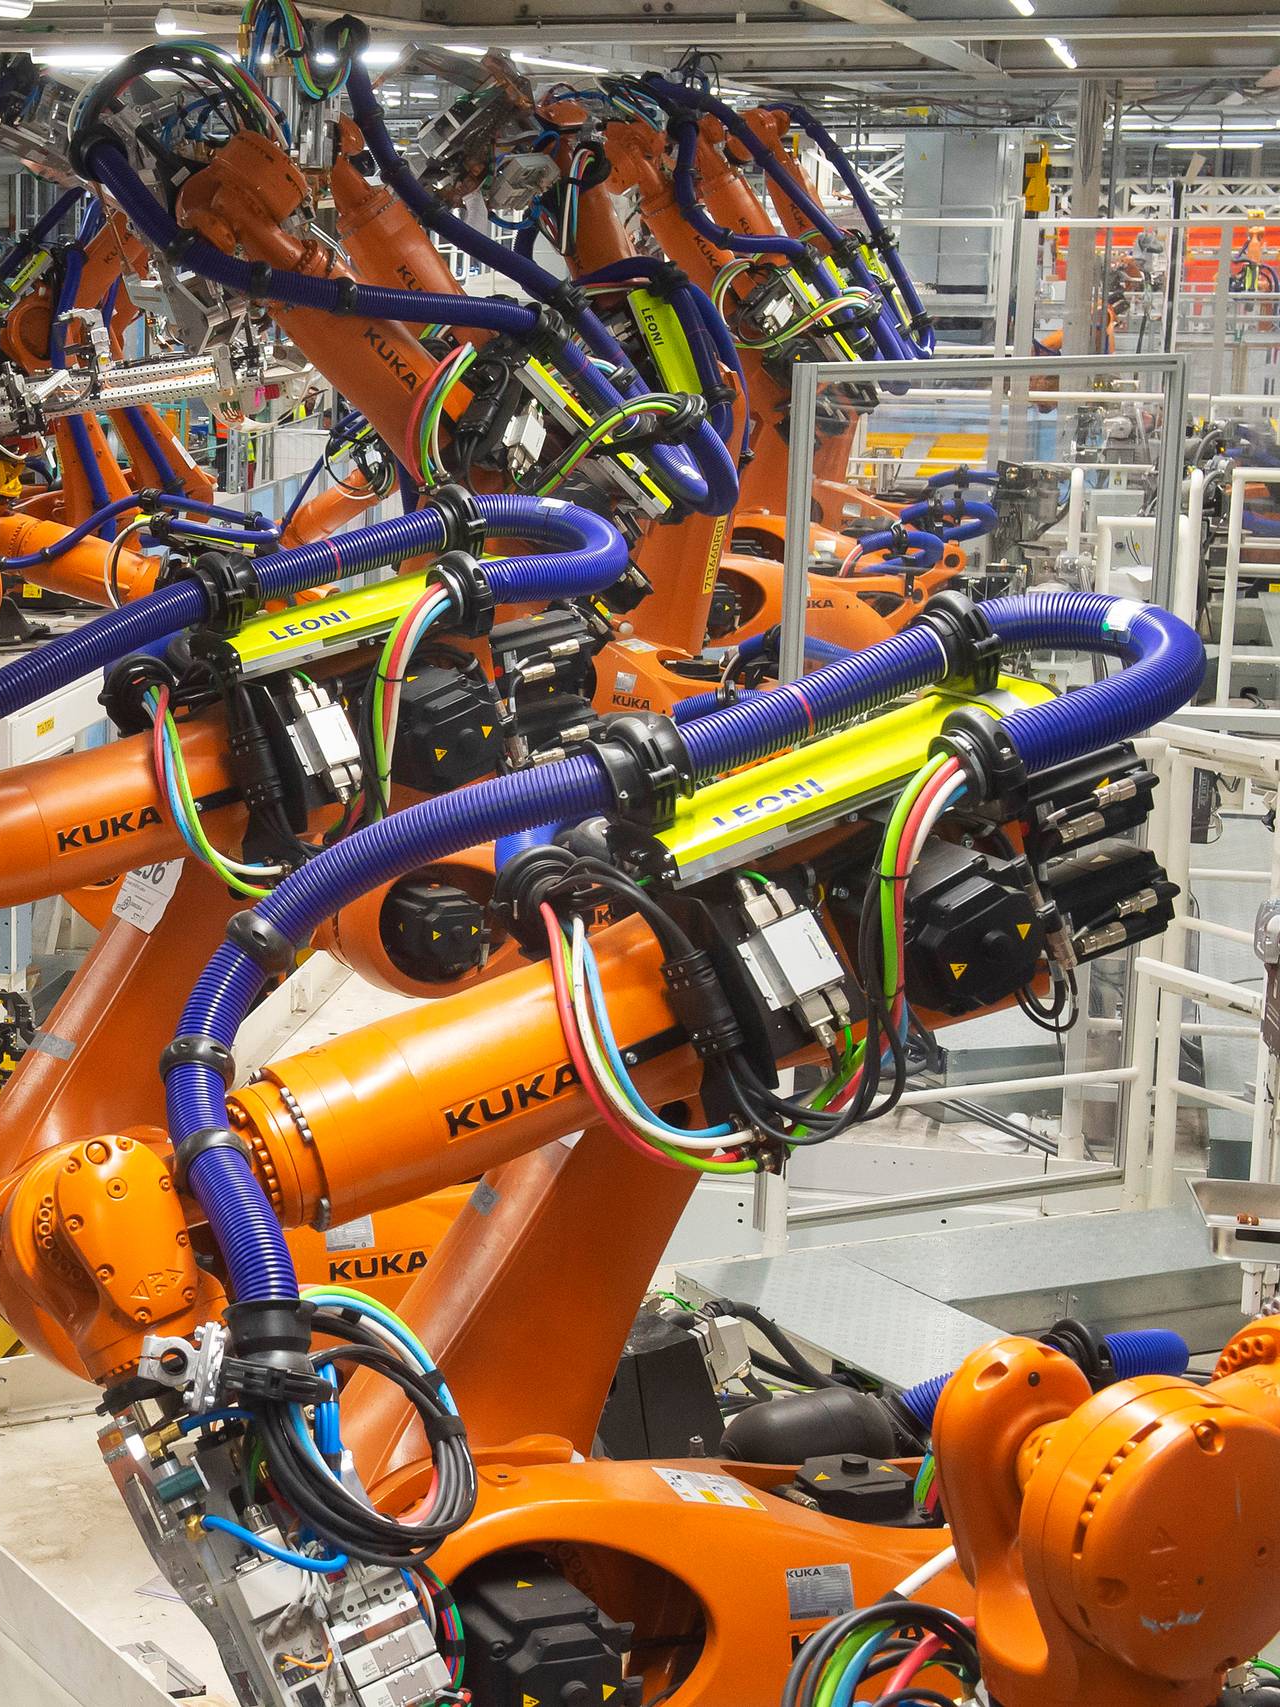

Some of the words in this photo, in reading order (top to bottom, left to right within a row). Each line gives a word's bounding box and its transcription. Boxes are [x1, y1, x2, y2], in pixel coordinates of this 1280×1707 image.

[640, 307, 665, 346] LEONI
[363, 326, 417, 391] KUKA
[268, 609, 351, 641] LEONI
[612, 695, 650, 710] KUKA
[712, 778, 825, 831] LEONI
[57, 805, 163, 852] KUKA
[444, 1062, 582, 1137] KUKA
[329, 1251, 429, 1281] KUKA
[786, 1567, 821, 1579] KUKA
